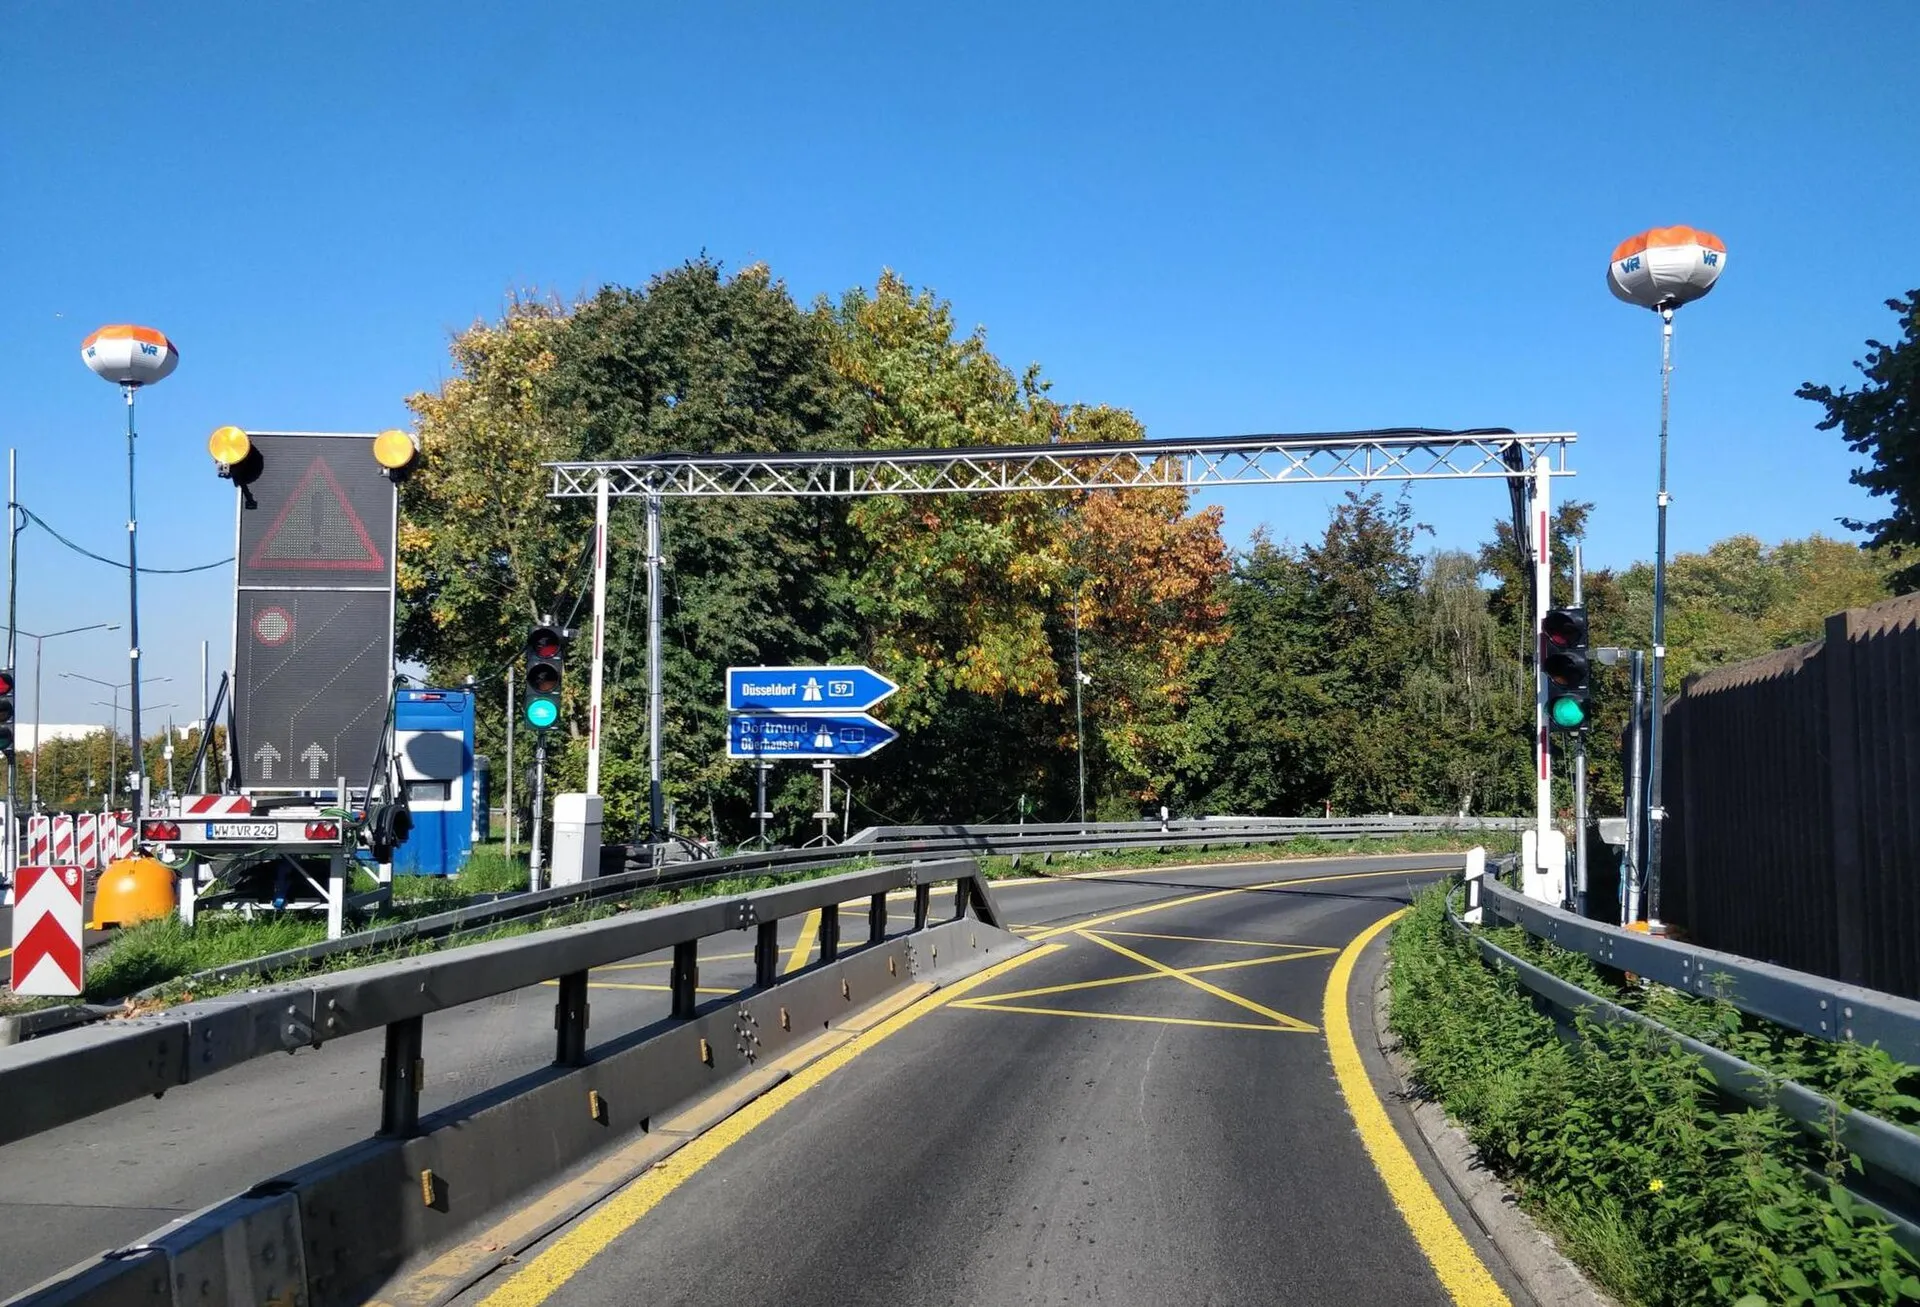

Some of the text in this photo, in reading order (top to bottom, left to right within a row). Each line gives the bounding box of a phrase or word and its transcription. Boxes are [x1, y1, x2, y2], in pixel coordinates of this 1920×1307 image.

[1620, 256, 1641, 274] VR
[1702, 250, 1718, 267] VR
[140, 342, 158, 357] VR
[742, 683, 796, 696] Düsseldorf
[834, 684, 847, 694] 59
[741, 721, 808, 734] Dortmund
[741, 737, 800, 751] Oberhausen
[214, 825, 275, 836] WW VR 242
